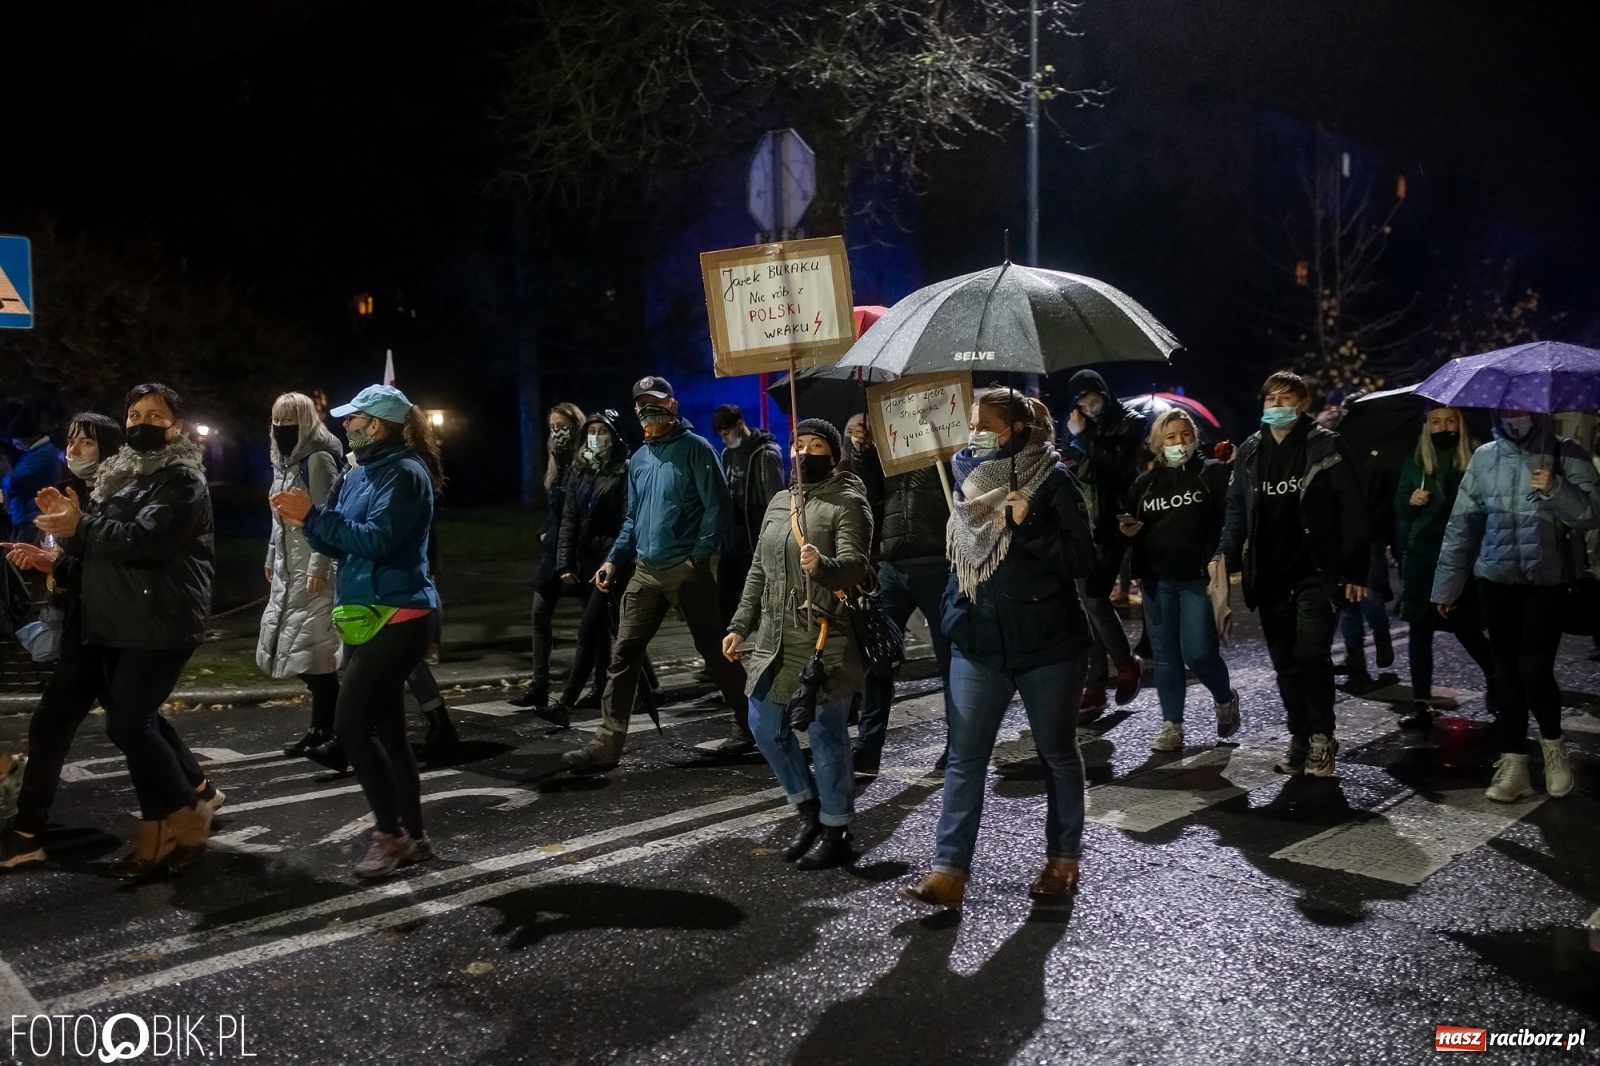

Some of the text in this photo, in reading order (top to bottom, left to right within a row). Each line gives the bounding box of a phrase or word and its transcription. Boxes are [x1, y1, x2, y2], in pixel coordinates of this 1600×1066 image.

[722, 261, 819, 302] Jarek BURAKU
[749, 285, 804, 305] Nie rób z
[749, 303, 801, 323] POLSKI
[764, 324, 809, 339] WRAKU
[954, 350, 995, 361] SELVE
[885, 391, 914, 413] Jarek
[1143, 489, 1203, 512] MIŁOŚĆ
